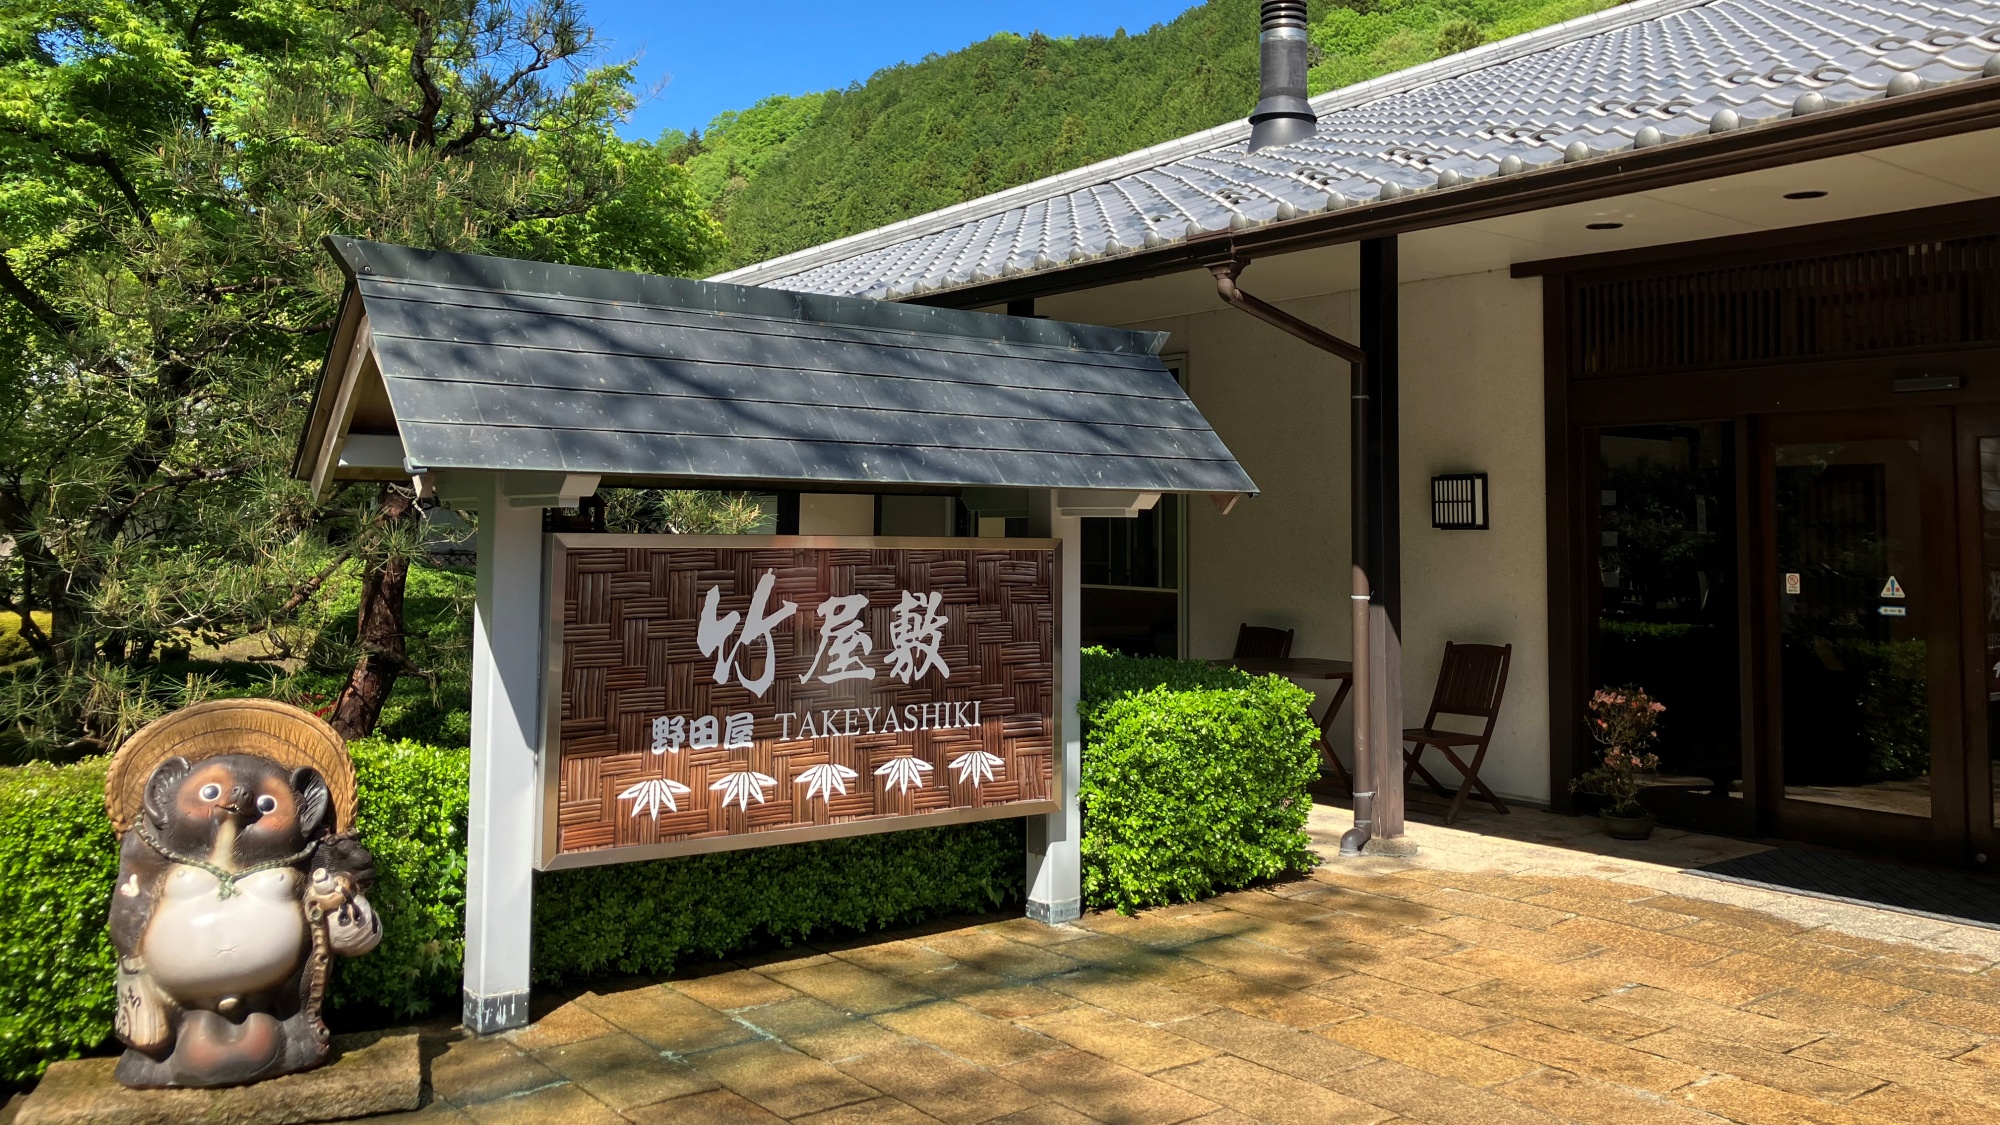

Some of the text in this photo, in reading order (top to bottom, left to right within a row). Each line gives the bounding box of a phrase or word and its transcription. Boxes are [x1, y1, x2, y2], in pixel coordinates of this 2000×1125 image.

[697, 568, 949, 698] 竹屋敷
[652, 712, 755, 755] 野田屋
[774, 700, 982, 742] TAKEYASHIKI
